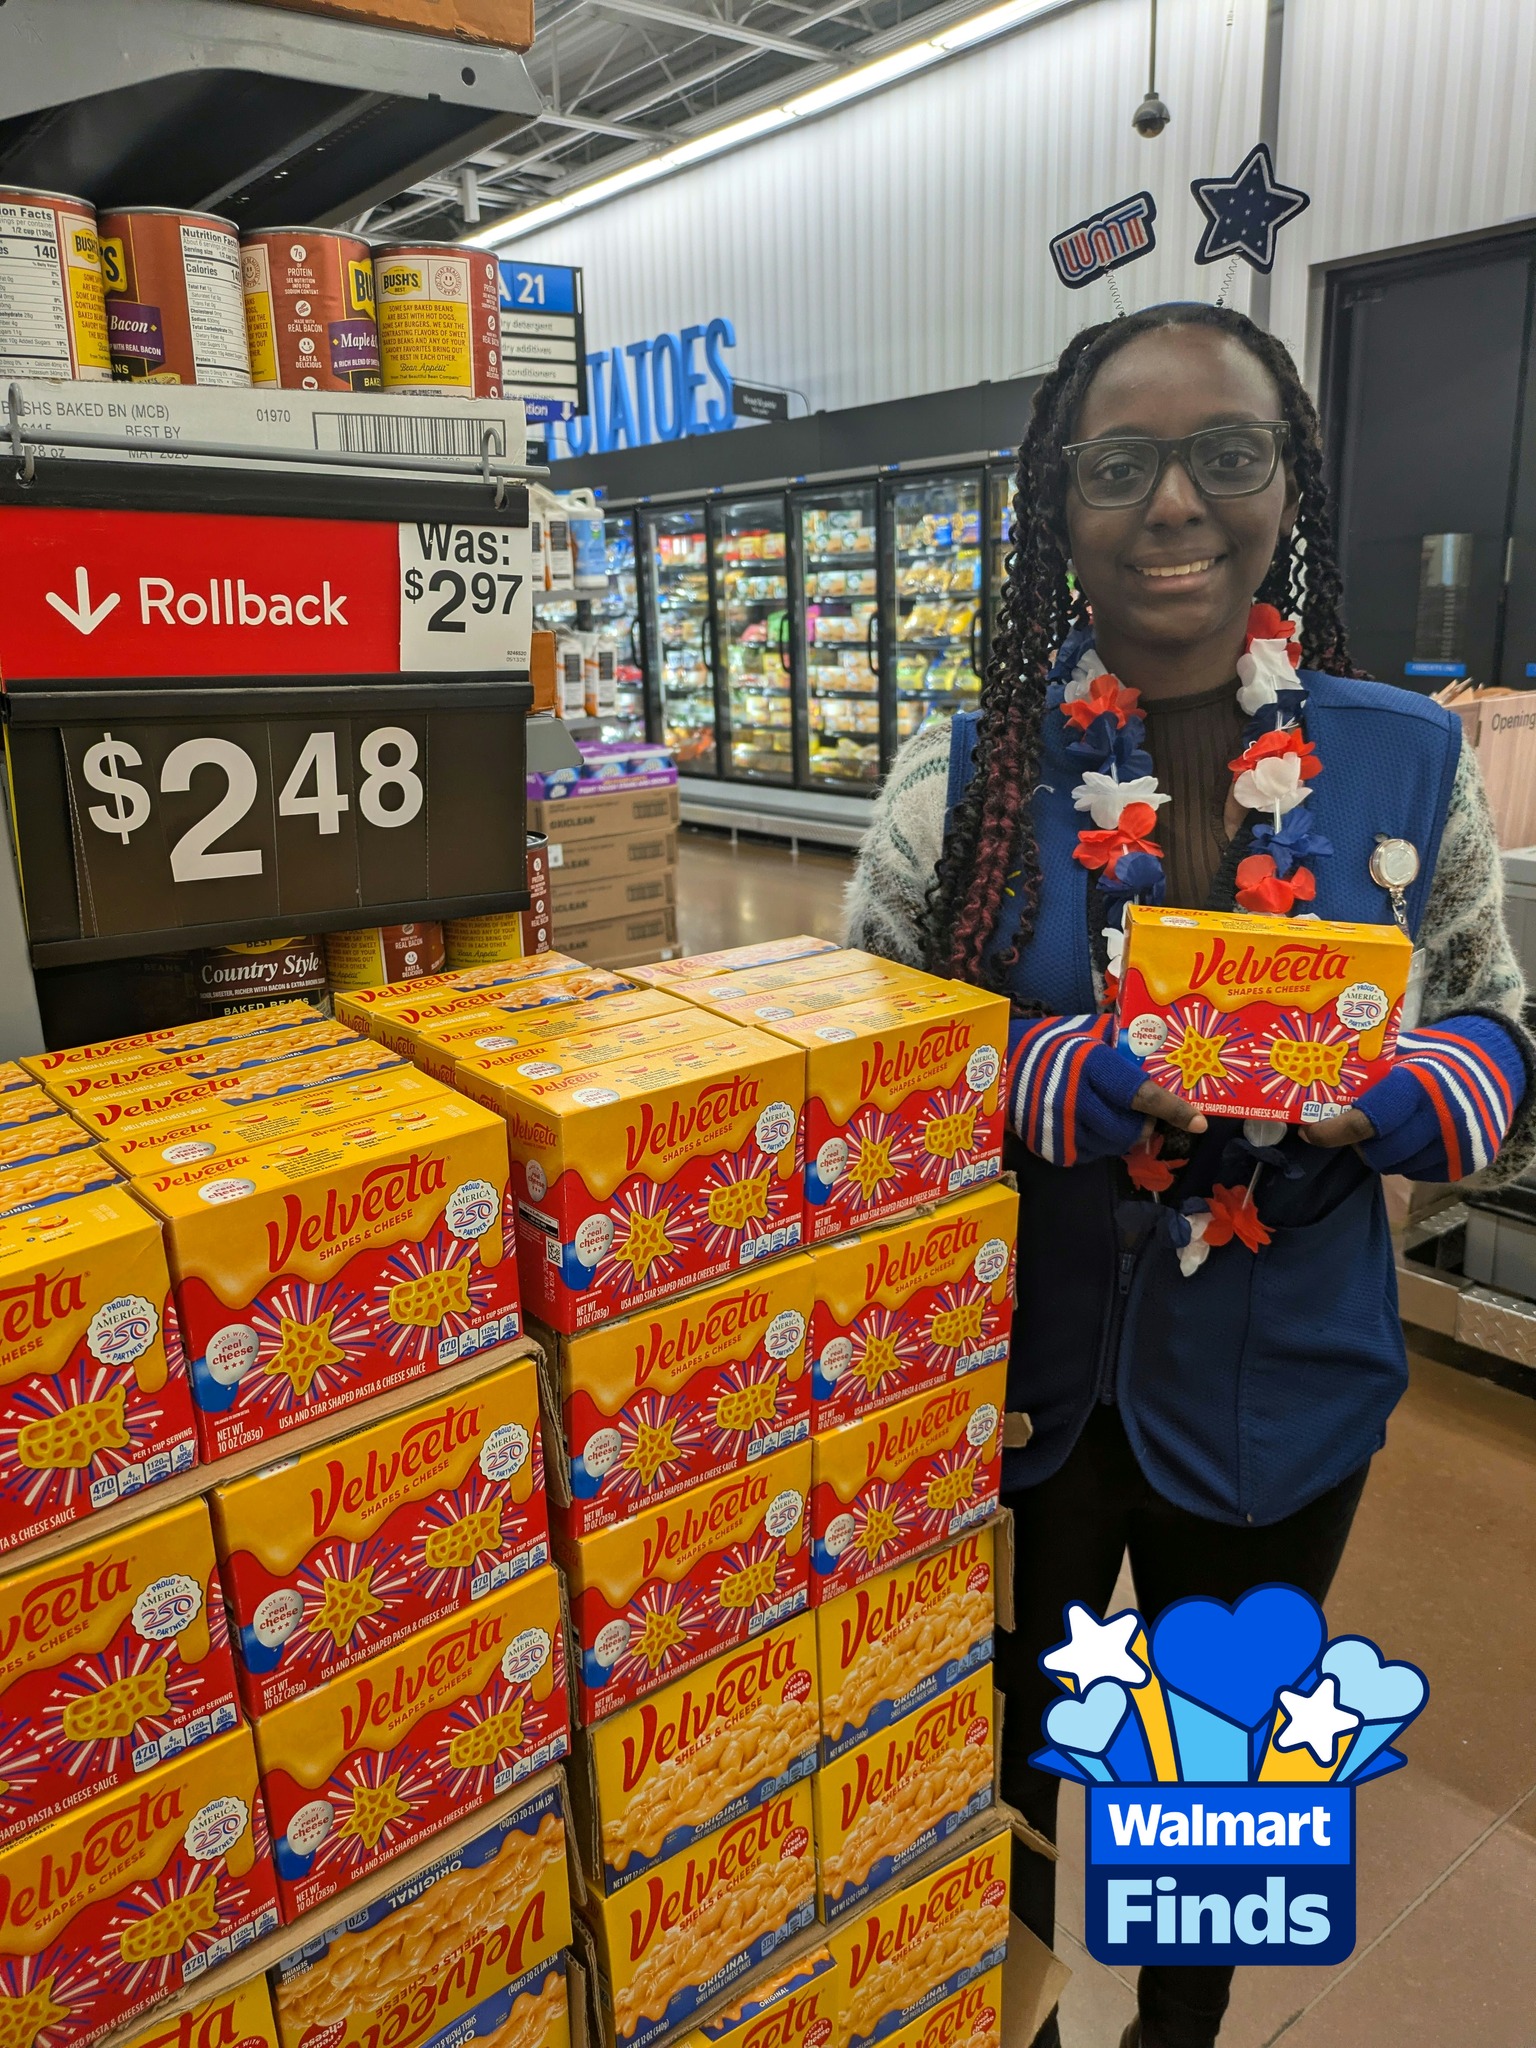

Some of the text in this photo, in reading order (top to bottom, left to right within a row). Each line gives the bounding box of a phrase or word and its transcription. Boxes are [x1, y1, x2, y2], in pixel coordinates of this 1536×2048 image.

[20, 208, 52, 220] Facts
[182, 228, 222, 244] Nutrition
[34, 244, 57, 259] 140
[294, 248, 302, 260] 7g
[186, 263, 218, 276] Calories
[287, 268, 313, 277] PROTEIN
[384, 272, 419, 290] BUSH'S
[517, 273, 545, 305] 21
[404, 304, 414, 312] SAY
[414, 304, 432, 312] BAKED
[110, 316, 148, 333] Bacon
[288, 324, 323, 332] REAL BACON
[125, 344, 140, 352] REAL
[140, 346, 162, 356] BACON
[341, 333, 370, 350] Maple
[437, 354, 457, 362] OTHER.
[507, 368, 557, 378] conditioners
[544, 317, 737, 463] TATOES
[2, 402, 291, 423] BSHS BAKED BN (MCB) 01970
[126, 426, 181, 439] BEST BY
[416, 522, 510, 566] Was:
[139, 577, 349, 627] Rollback
[1492, 712, 1536, 734] Opening
[396, 938, 424, 950] REAL BACON
[202, 952, 319, 985] Country Style
[1189, 938, 1351, 990] Velveeta
[234, 986, 254, 996] RICHER
[254, 985, 268, 994] WITH
[268, 982, 286, 992] BACON
[291, 980, 305, 989] EXTRA
[1227, 984, 1311, 996] SHAPES & CHEESE
[1344, 992, 1382, 1002] AMERICA
[1356, 982, 1375, 992] PROUD
[1342, 1000, 1382, 1020] 250
[1132, 1031, 1163, 1041] cheese
[40, 1030, 176, 1070] Velveeta
[860, 1018, 971, 1101] Velveeta
[64, 1052, 206, 1098] Velveeta
[303, 1075, 344, 1089] ORIGINAL
[93, 1075, 241, 1127] Velveeta
[1204, 1102, 1227, 1114] SHAPED
[1227, 1104, 1245, 1115] PASTA
[1245, 1106, 1250, 1116] &
[1250, 1107, 1271, 1118] CHEESE
[1271, 1109, 1290, 1120] SAUCE
[1304, 1104, 1320, 1112] 470
[625, 1072, 761, 1172] Velveeta
[451, 1189, 492, 1208] AMERICA
[462, 1182, 481, 1194] PROUD
[265, 1150, 447, 1274] Velveeta
[452, 1200, 494, 1229] 250
[319, 1208, 414, 1261] SHAPES & CHEESE
[462, 1222, 488, 1236] PARTNER
[865, 1216, 979, 1302] Velveeta
[106, 1298, 131, 1313] PROUD
[472, 1316, 481, 1326] PER
[486, 1310, 496, 1321] CUP
[497, 1302, 518, 1316] SERVING
[95, 1305, 146, 1331] AMERICA
[97, 1316, 151, 1354] 250
[214, 1331, 250, 1350] MADE WITH
[221, 1339, 242, 1352] real
[634, 1286, 769, 1387] Velveeta
[112, 1342, 144, 1361] PARTNER
[212, 1344, 254, 1366] cheese
[440, 1338, 456, 1354] 470
[278, 1362, 427, 1430] USA AND STAR SHAPED PASTA & CHEESE SAUCE
[166, 1426, 194, 1446] SERVING
[216, 1421, 244, 1442] NET WT
[218, 1426, 264, 1454] 10 OZ (283g)
[866, 1386, 970, 1478] Velveeta
[310, 1400, 482, 1538] Velveeta
[92, 1477, 115, 1496] 470
[642, 1471, 770, 1579] Velveeta
[840, 1532, 980, 1670] Velveeta
[340, 1612, 503, 1751] Velveeta
[622, 1630, 798, 1793] Velveeta
[674, 1698, 763, 1767] SHELLS & CHEESE
[840, 1682, 978, 1832] Velveeta
[694, 1796, 750, 1833] ORIGINAL
[388, 1859, 462, 1908] ORIGINAL
[629, 1791, 795, 1963] Velveeta
[848, 1852, 995, 1990] Velveeta
[696, 1950, 750, 1993] ORIGINAL
